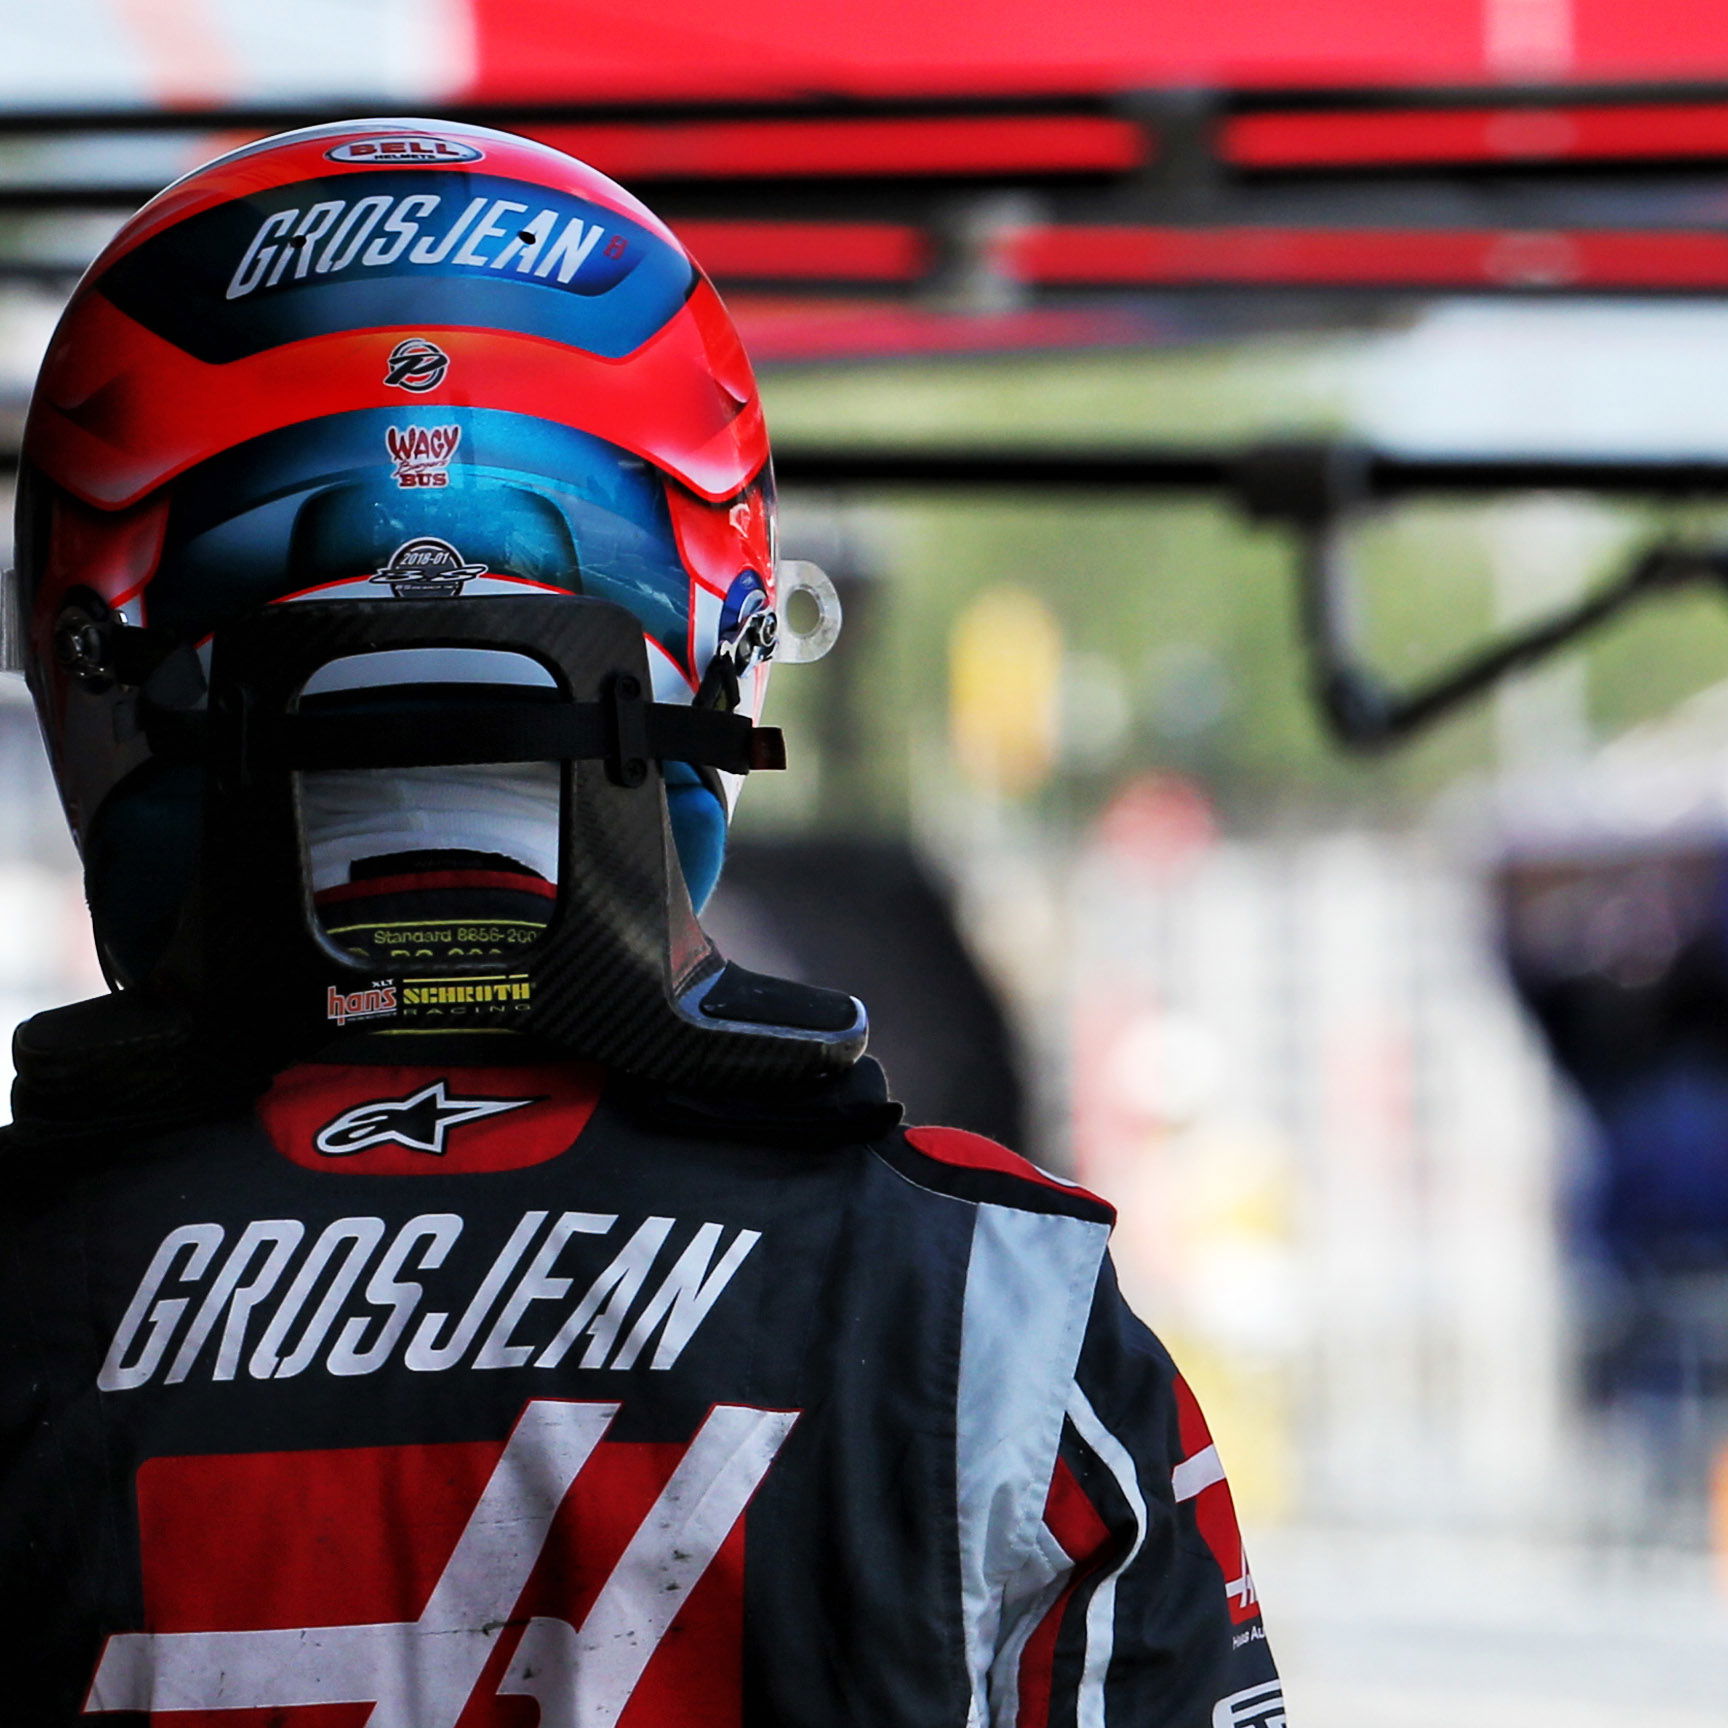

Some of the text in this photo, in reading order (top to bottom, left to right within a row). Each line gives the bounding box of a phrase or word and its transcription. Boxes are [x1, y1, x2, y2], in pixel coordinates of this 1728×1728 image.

[349, 142, 460, 156] BELL
[225, 195, 605, 300] GROSJEAN
[399, 473, 447, 487] BUS
[373, 929, 452, 944] Standard
[403, 982, 531, 1004] SCHROTH
[328, 985, 397, 1026] hans
[403, 1003, 531, 1016] RACING
[96, 1210, 763, 1391] GROSJEAN
